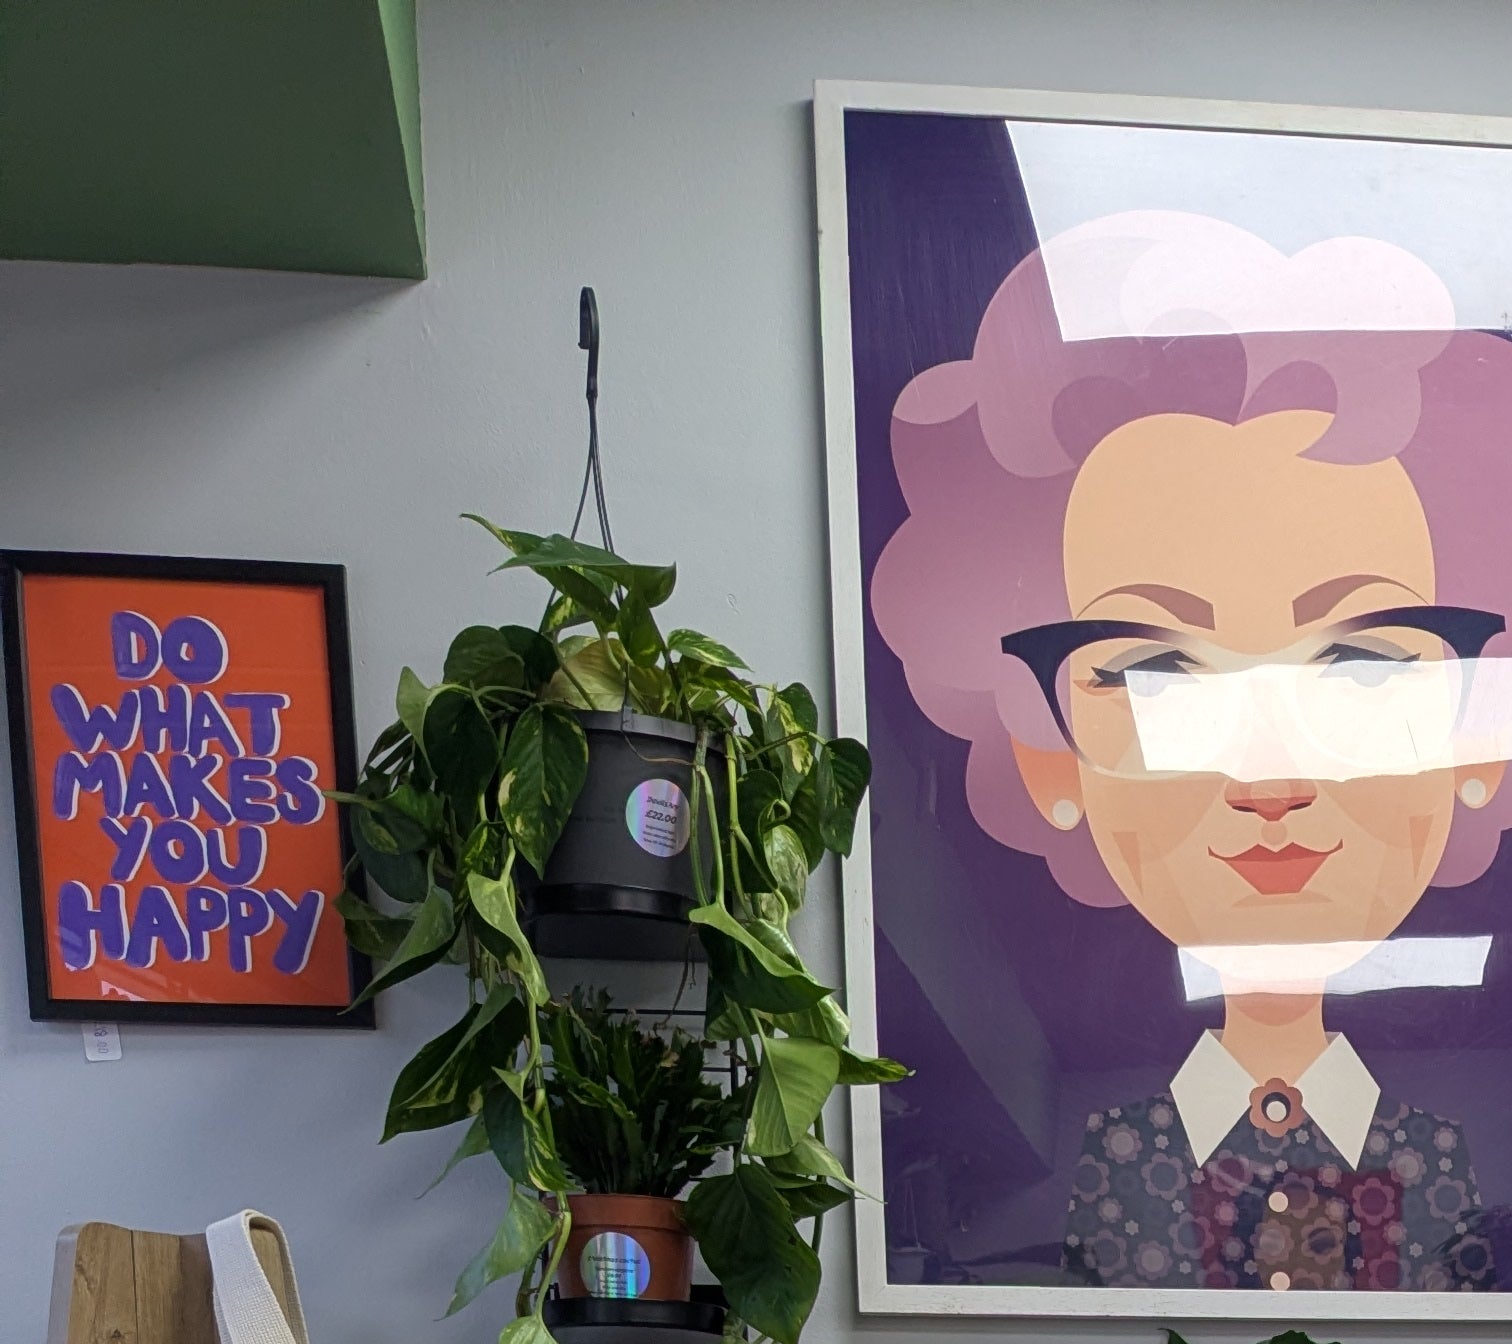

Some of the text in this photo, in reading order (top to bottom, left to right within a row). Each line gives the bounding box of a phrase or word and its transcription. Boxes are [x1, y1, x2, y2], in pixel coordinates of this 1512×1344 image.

[110, 610, 229, 684] DO
[50, 683, 290, 758] WHAT
[52, 751, 325, 825] MAKES
[100, 815, 267, 886] YOU
[57, 880, 324, 975] HAPPY
